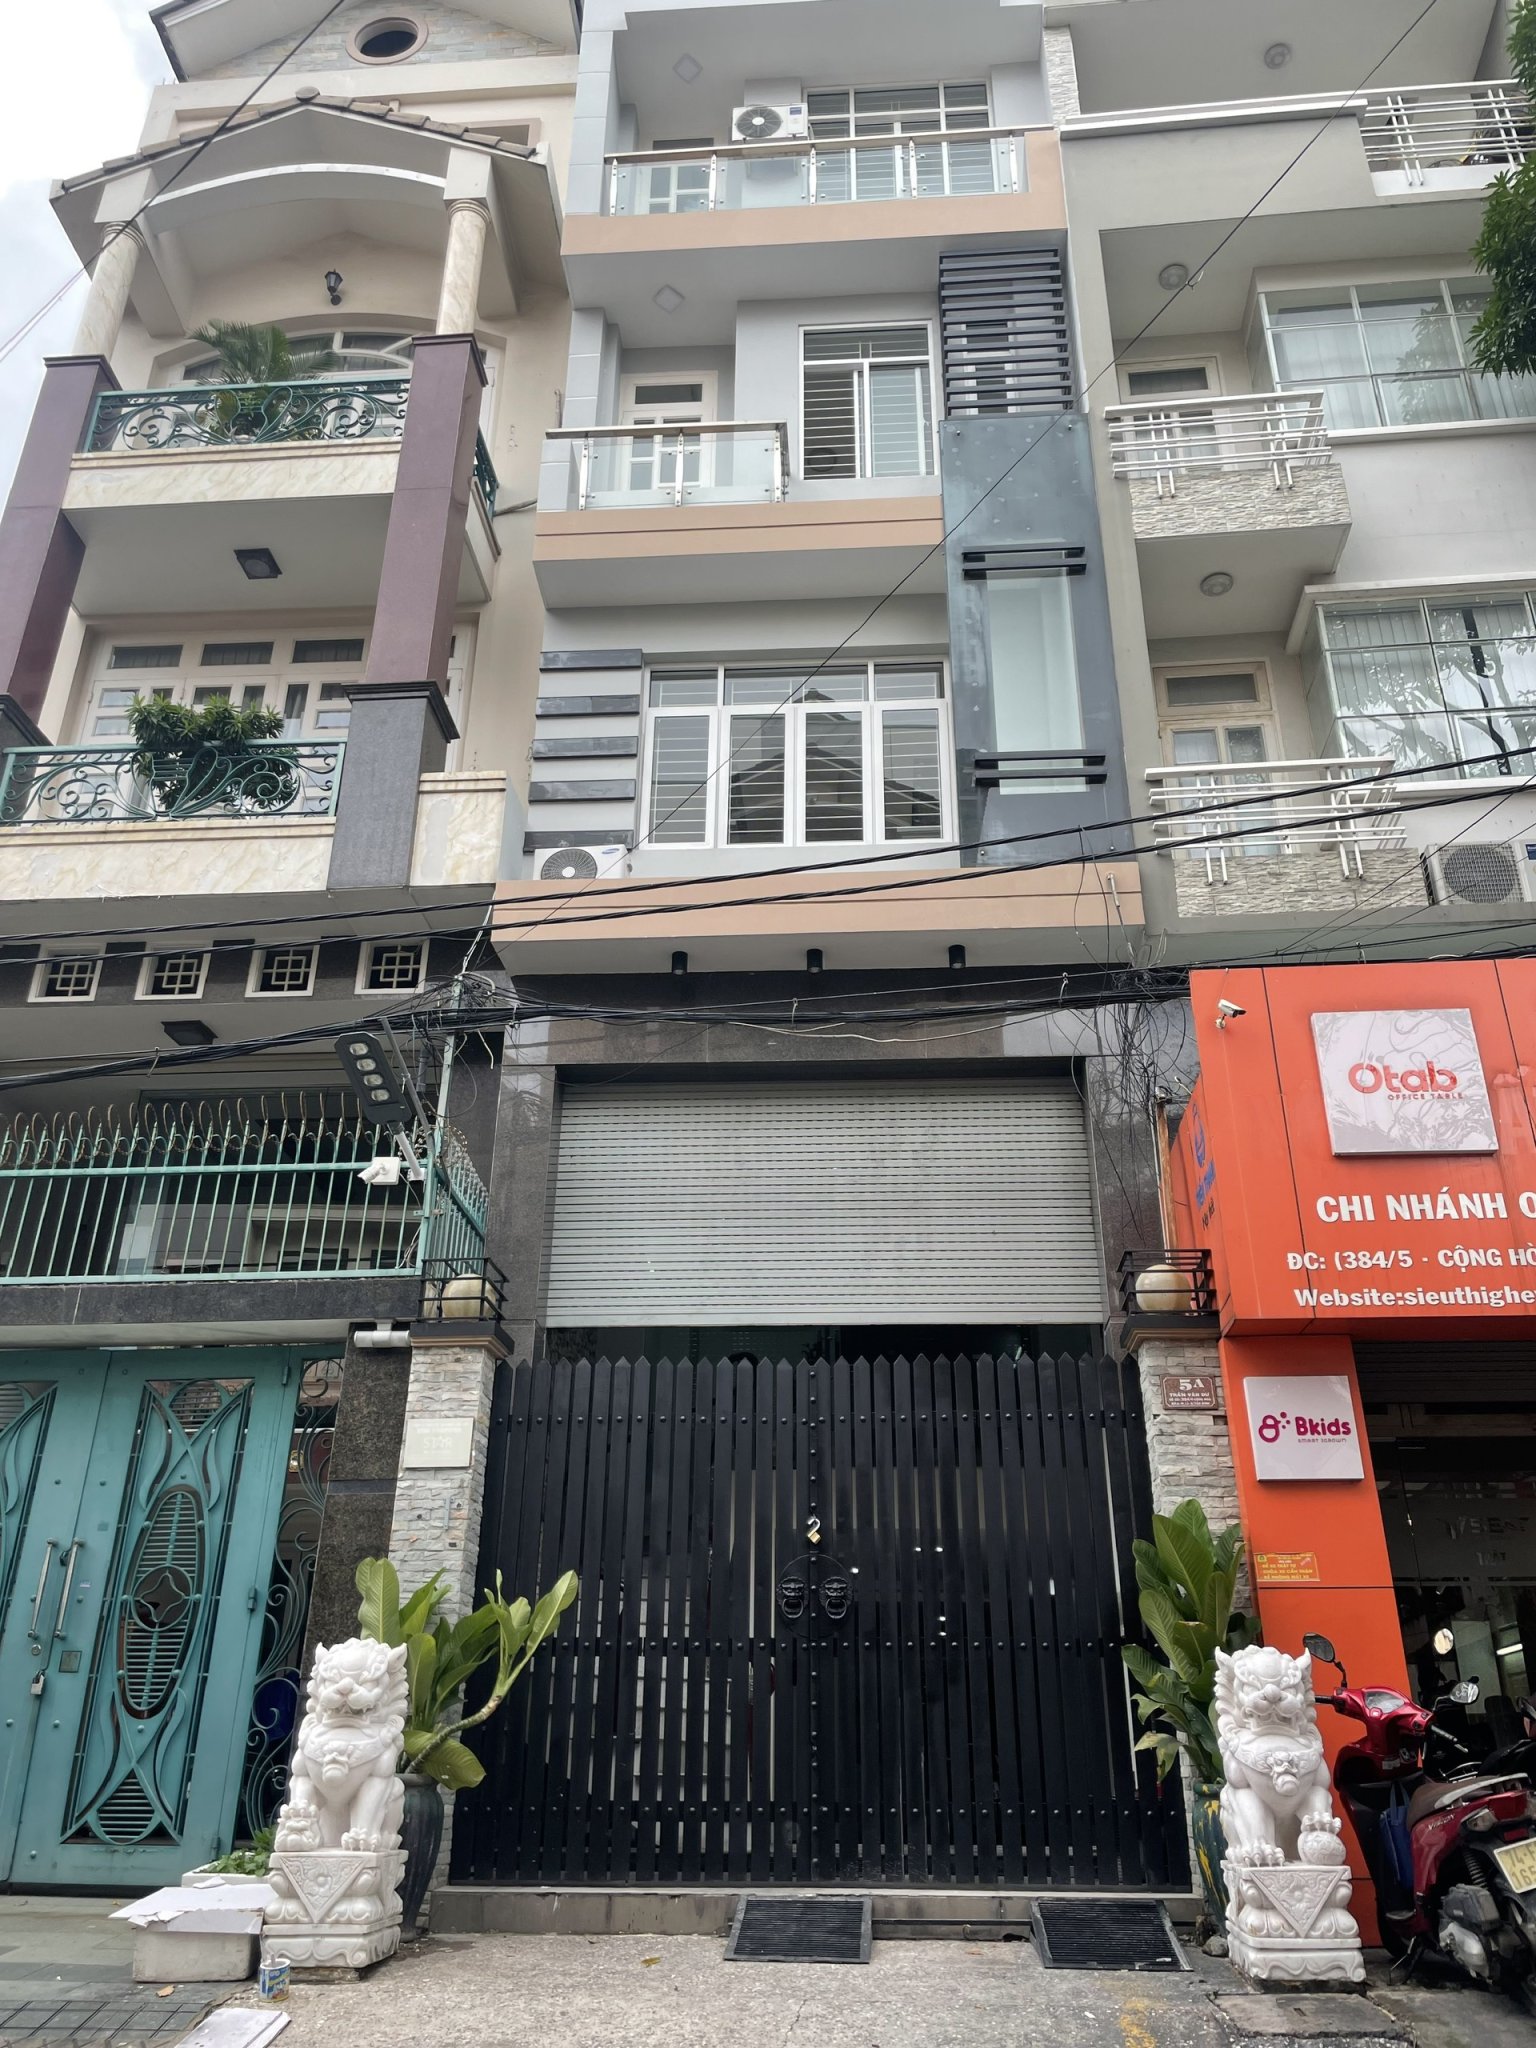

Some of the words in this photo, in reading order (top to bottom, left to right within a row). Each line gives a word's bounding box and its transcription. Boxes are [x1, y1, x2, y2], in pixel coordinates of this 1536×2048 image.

[1347, 1060, 1458, 1094] Otab
[1387, 1093, 1426, 1101] OFFICE
[1316, 1194, 1375, 1223] CHI
[1385, 1186, 1509, 1222] NHÁNH
[1286, 1251, 1327, 1271] ĐC:
[1334, 1249, 1413, 1271] (384/5
[1438, 1245, 1503, 1273] CỘNG
[1293, 1285, 1536, 1308] Website:sieuthighe
[1178, 1378, 1205, 1391] 5A
[1294, 1416, 1352, 1436] Bkids
